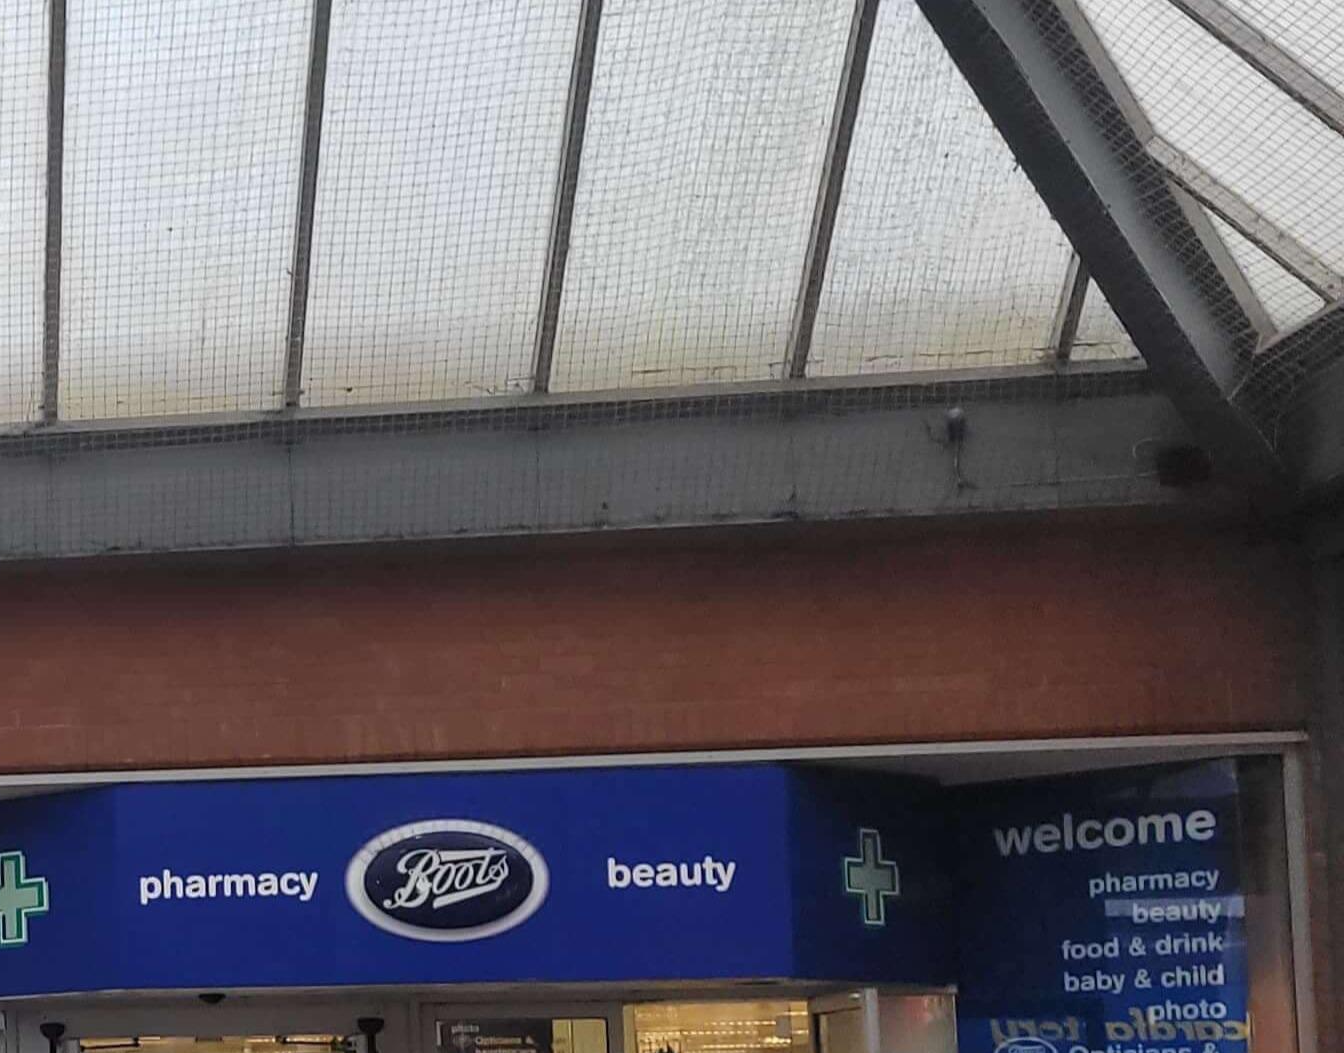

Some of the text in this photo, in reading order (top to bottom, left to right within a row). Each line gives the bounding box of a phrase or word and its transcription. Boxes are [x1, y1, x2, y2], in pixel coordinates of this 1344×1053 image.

[994, 809, 1216, 857] welcome
[139, 849, 736, 909] pharmacy Boots beauty
[1089, 869, 1220, 898] pharmacy
[1132, 899, 1221, 923] beauty
[1063, 932, 1224, 960] food & drink
[1064, 964, 1224, 993] baby & child
[1149, 1000, 1227, 1025] photo
